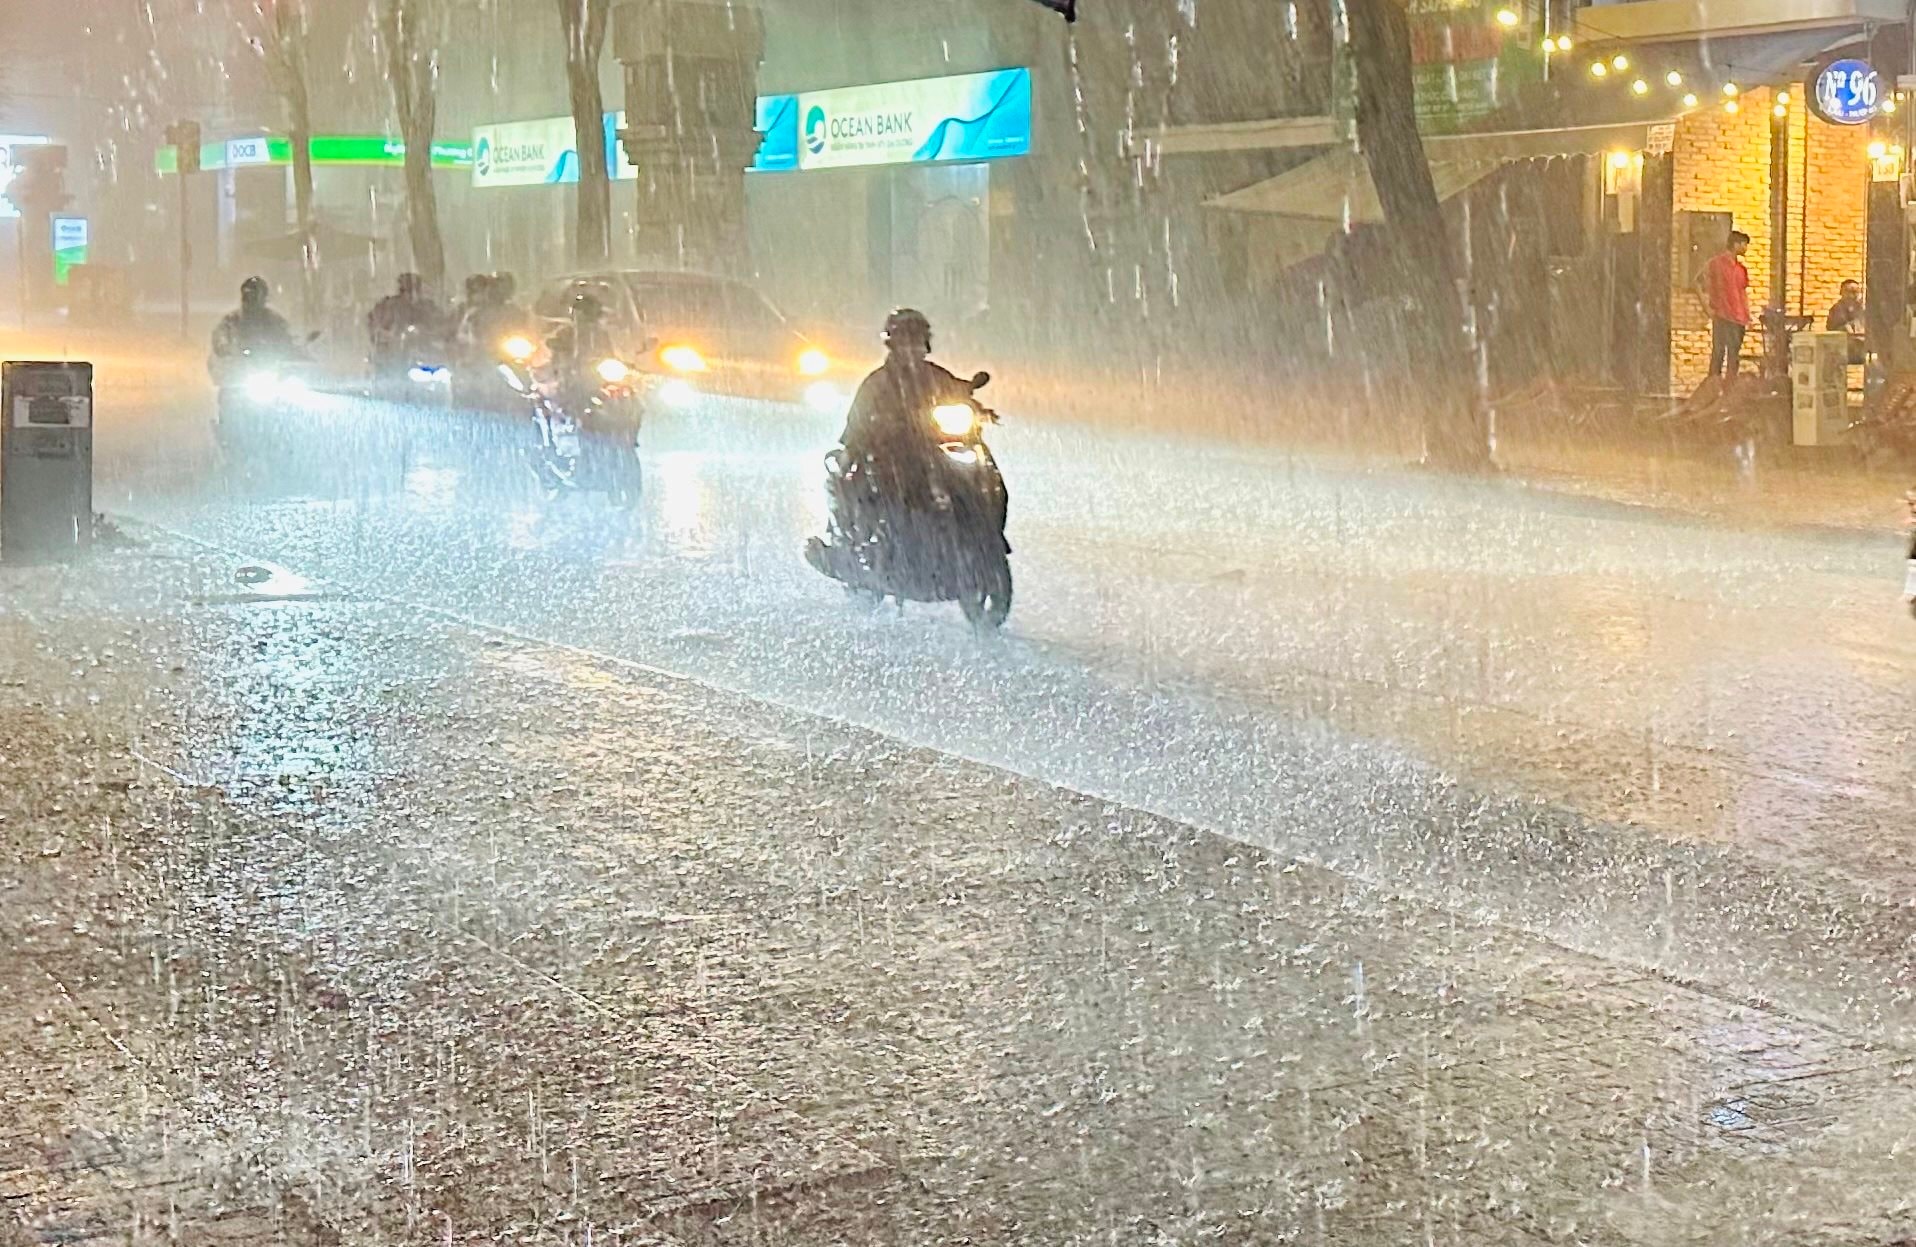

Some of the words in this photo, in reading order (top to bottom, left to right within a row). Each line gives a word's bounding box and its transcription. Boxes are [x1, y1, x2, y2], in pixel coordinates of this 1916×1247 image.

[1848, 70, 1878, 106] 96
[831, 115, 873, 139] OCEAN
[876, 111, 913, 135] BANK
[493, 144, 520, 164] OCEAN
[521, 144, 545, 162] BANK
